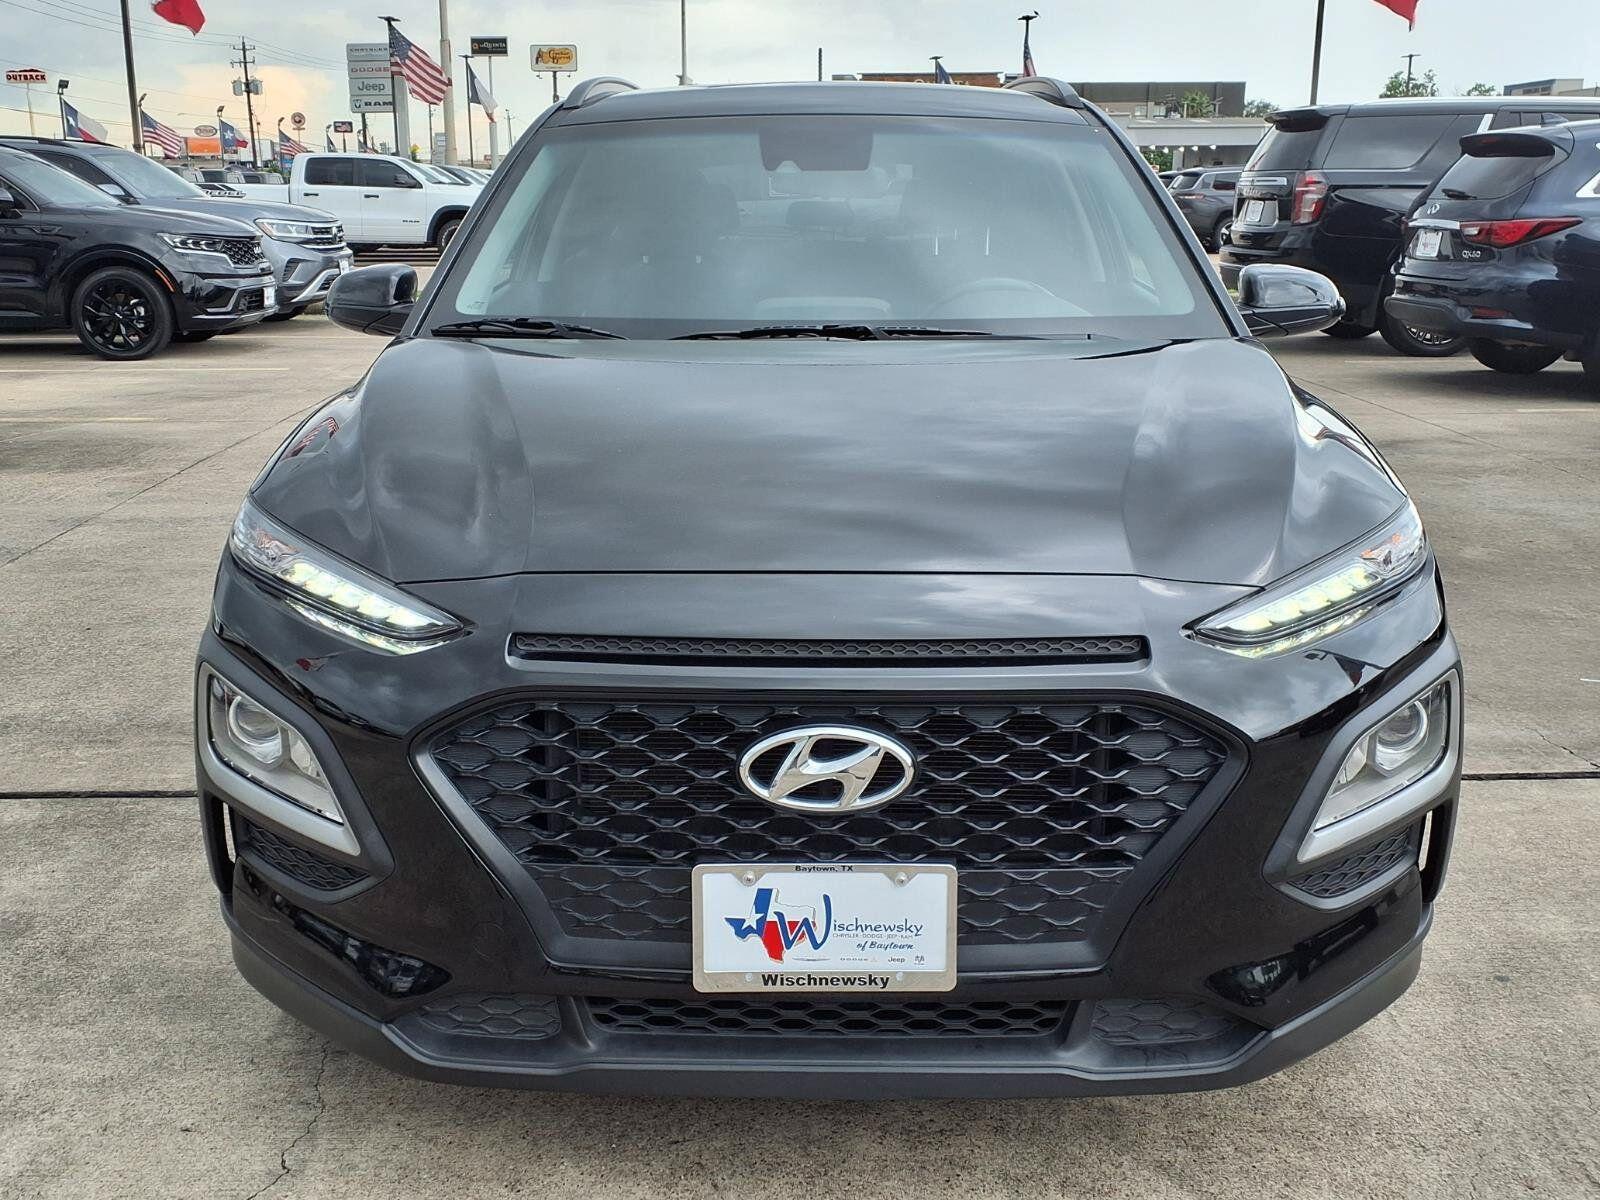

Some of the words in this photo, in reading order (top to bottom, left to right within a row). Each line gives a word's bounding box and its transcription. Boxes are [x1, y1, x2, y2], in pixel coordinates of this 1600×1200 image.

[357, 81, 386, 92] Jeep
[795, 865, 838, 873] Baytown,
[856, 940, 868, 952] of
[868, 940, 914, 951] Baytown
[888, 956, 906, 964] Jeep
[762, 973, 890, 989] Wischnewsky
